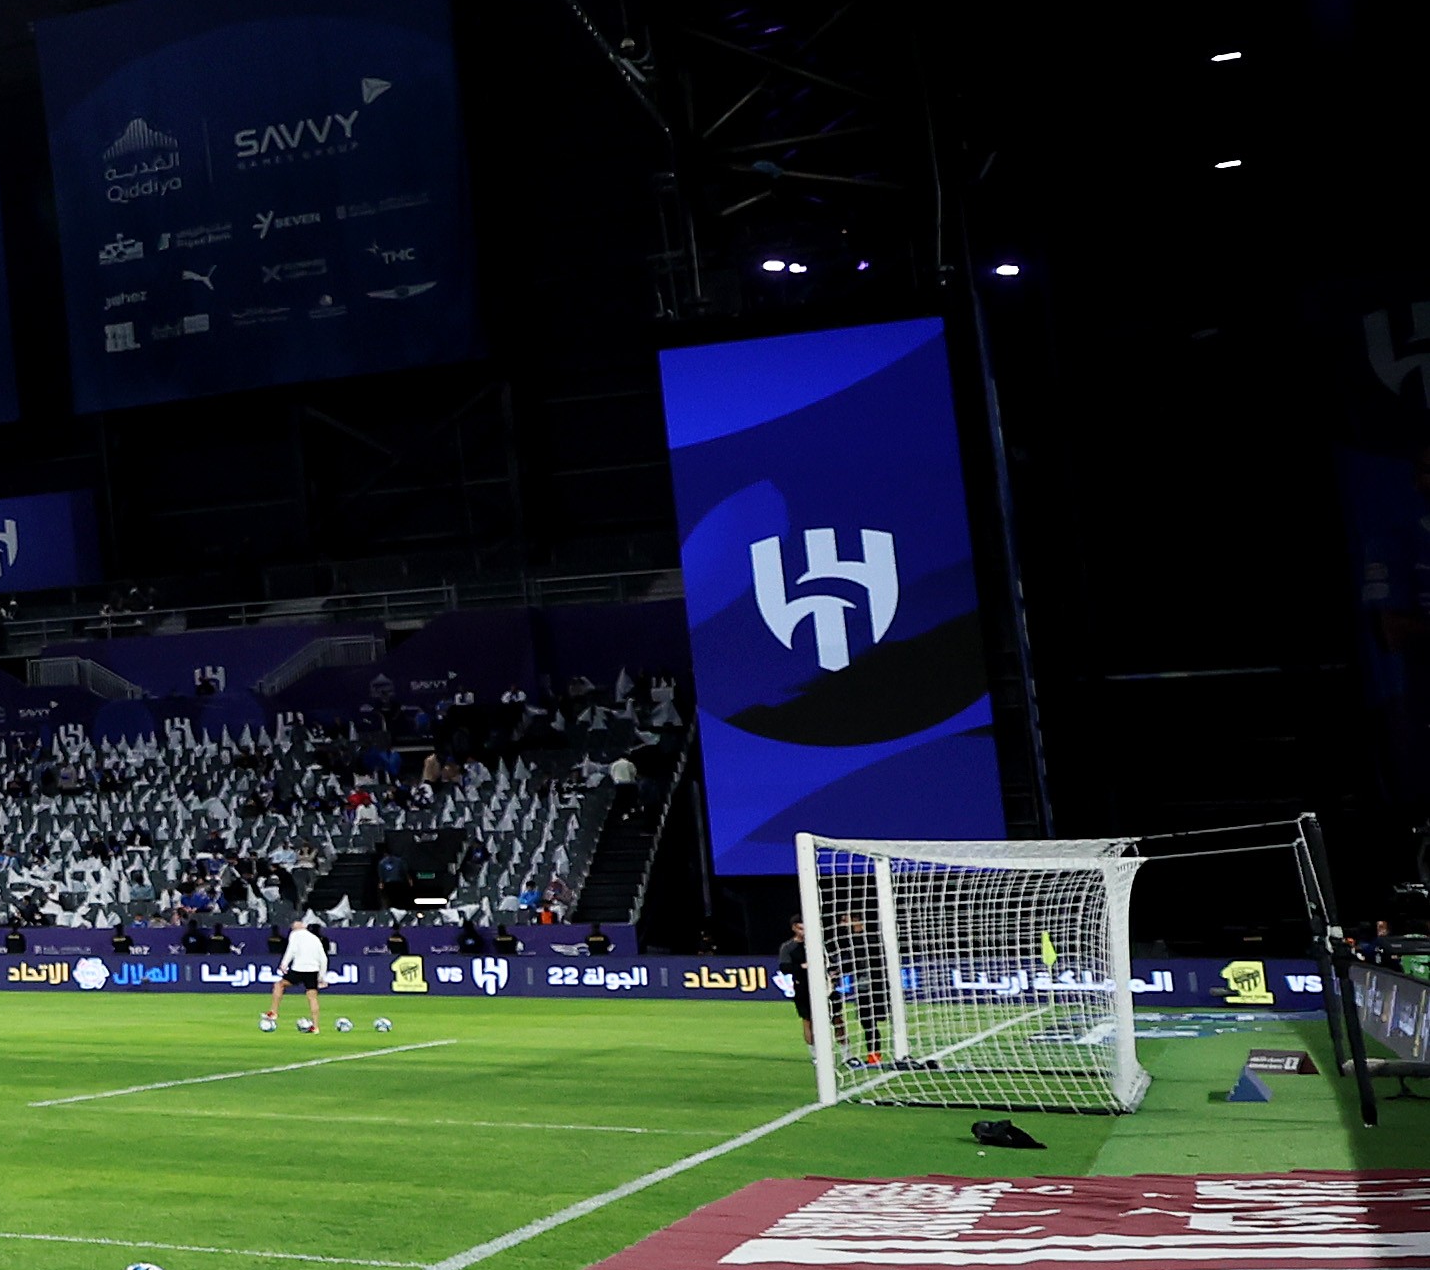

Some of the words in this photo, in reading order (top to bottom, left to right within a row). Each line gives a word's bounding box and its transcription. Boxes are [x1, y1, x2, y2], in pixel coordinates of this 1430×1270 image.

[233, 109, 359, 158] SAVVY
[106, 176, 182, 204] Qiddiya
[7, 961, 69, 985] الاتحاد
[112, 961, 178, 985] الهلال
[547, 966, 580, 985] 22
[582, 966, 649, 991] الجولة
[683, 966, 767, 992] الاتحاد
